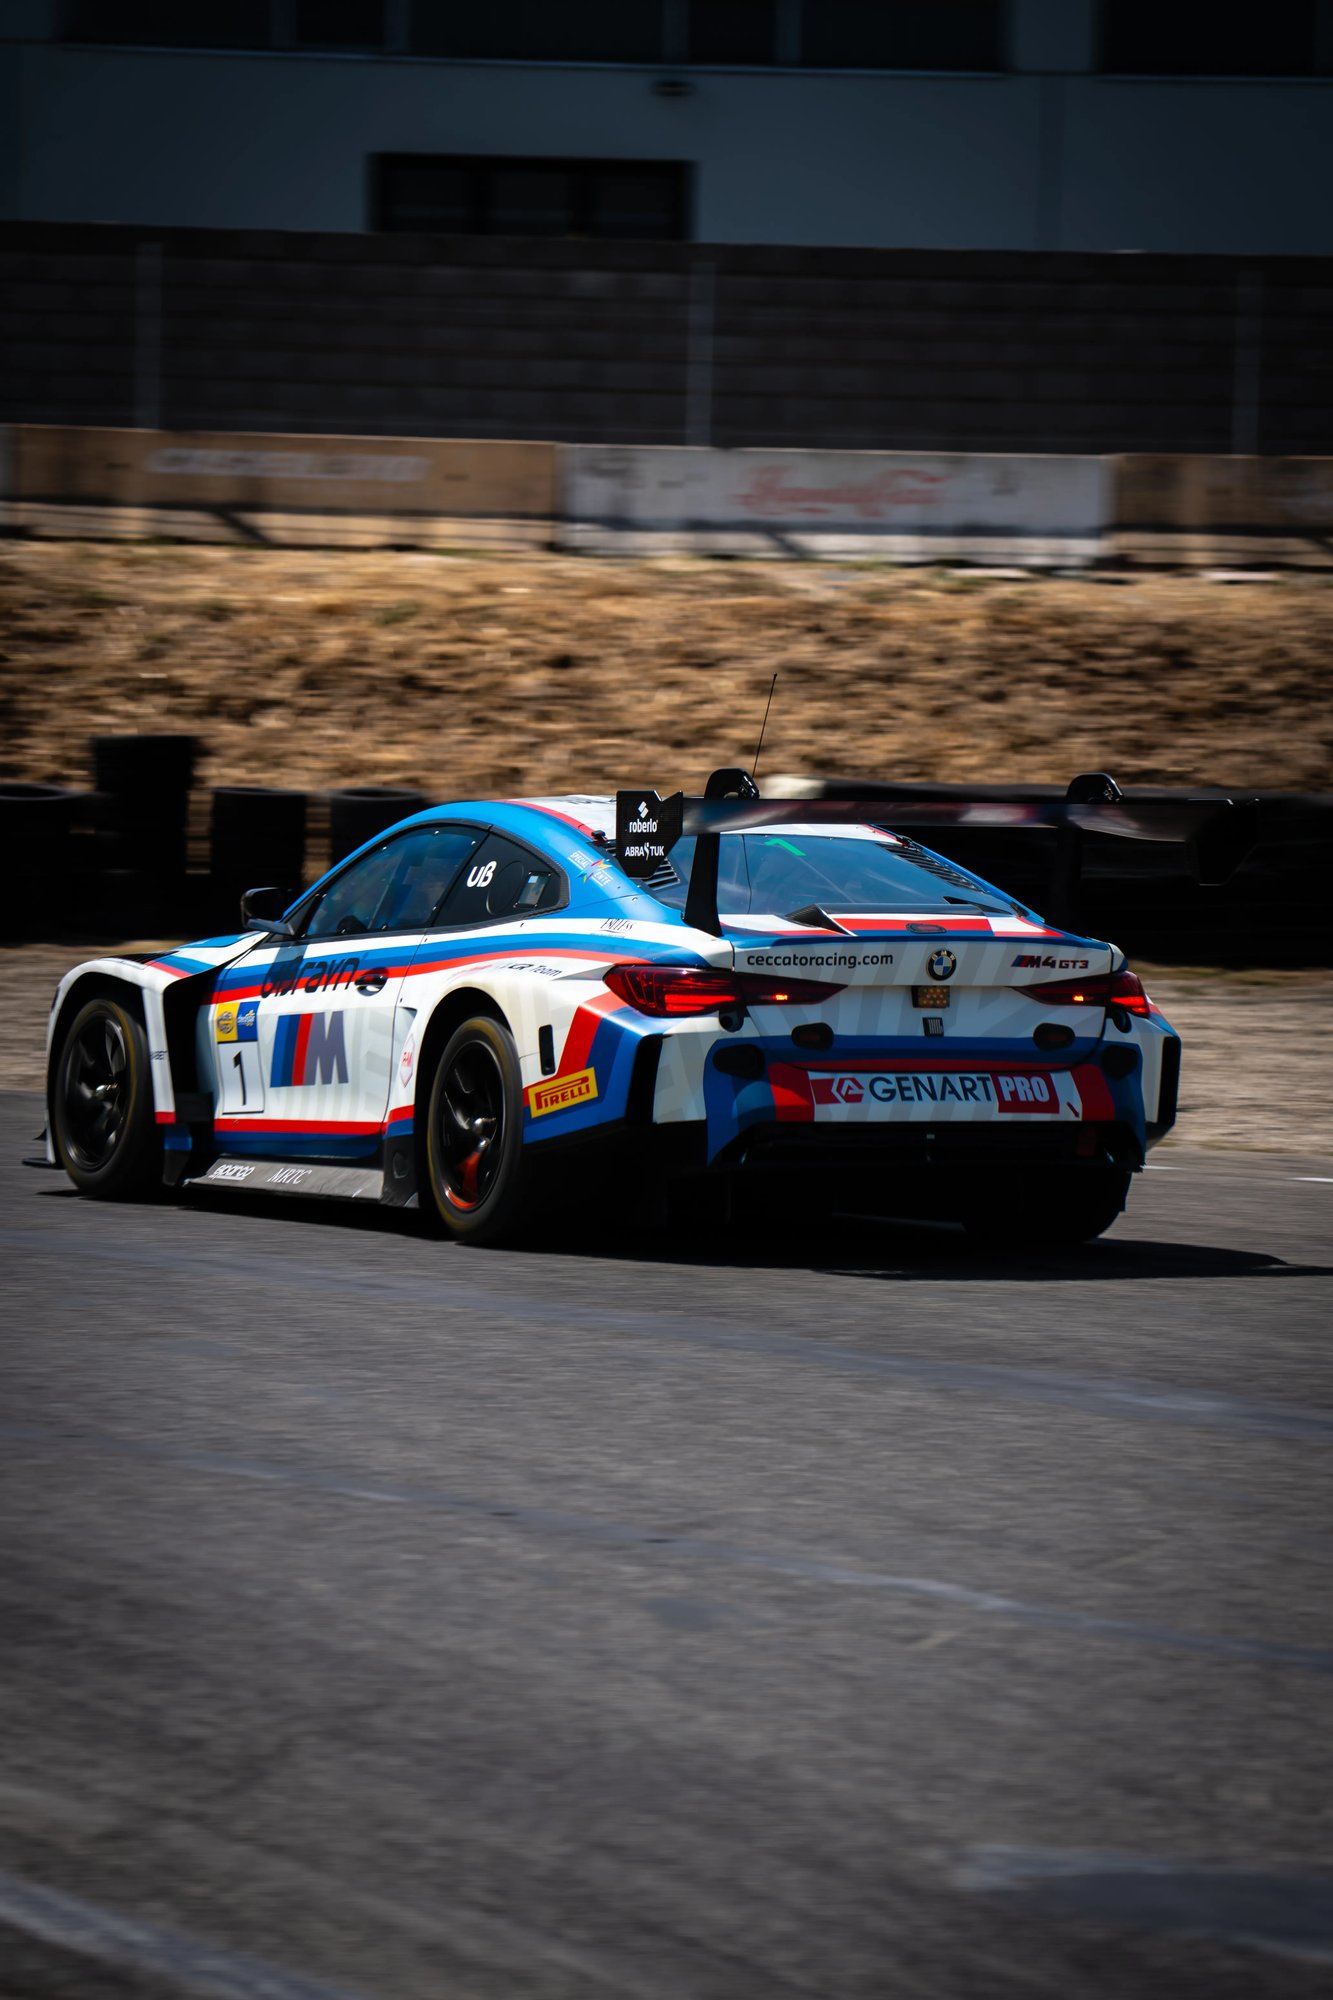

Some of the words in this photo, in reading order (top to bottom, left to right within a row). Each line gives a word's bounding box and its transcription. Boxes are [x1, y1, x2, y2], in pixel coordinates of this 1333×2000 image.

[629, 818, 657, 833] roberlo
[747, 953, 893, 968] ceccatoracing.com
[1059, 960, 1089, 969] GT3
[298, 1011, 349, 1087] M
[233, 1050, 247, 1106] 1
[869, 1076, 993, 1102] GENART
[998, 1076, 1050, 1102] PRO
[535, 1076, 590, 1110] PIRELLI
